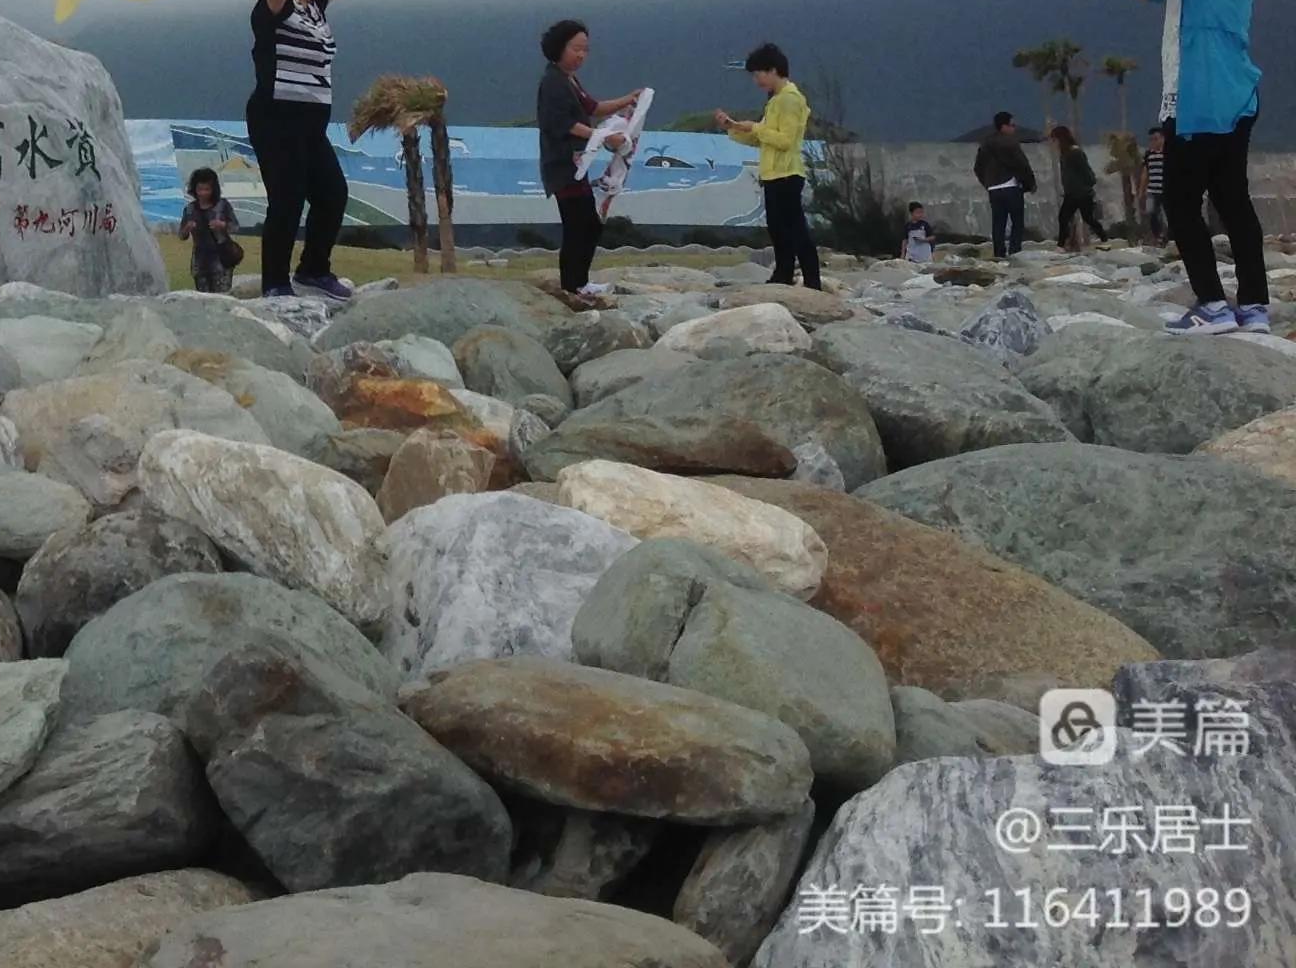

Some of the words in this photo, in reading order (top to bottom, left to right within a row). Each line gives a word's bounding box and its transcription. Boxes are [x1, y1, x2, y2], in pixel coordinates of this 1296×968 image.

[13, 203, 118, 240] 第九河川局
